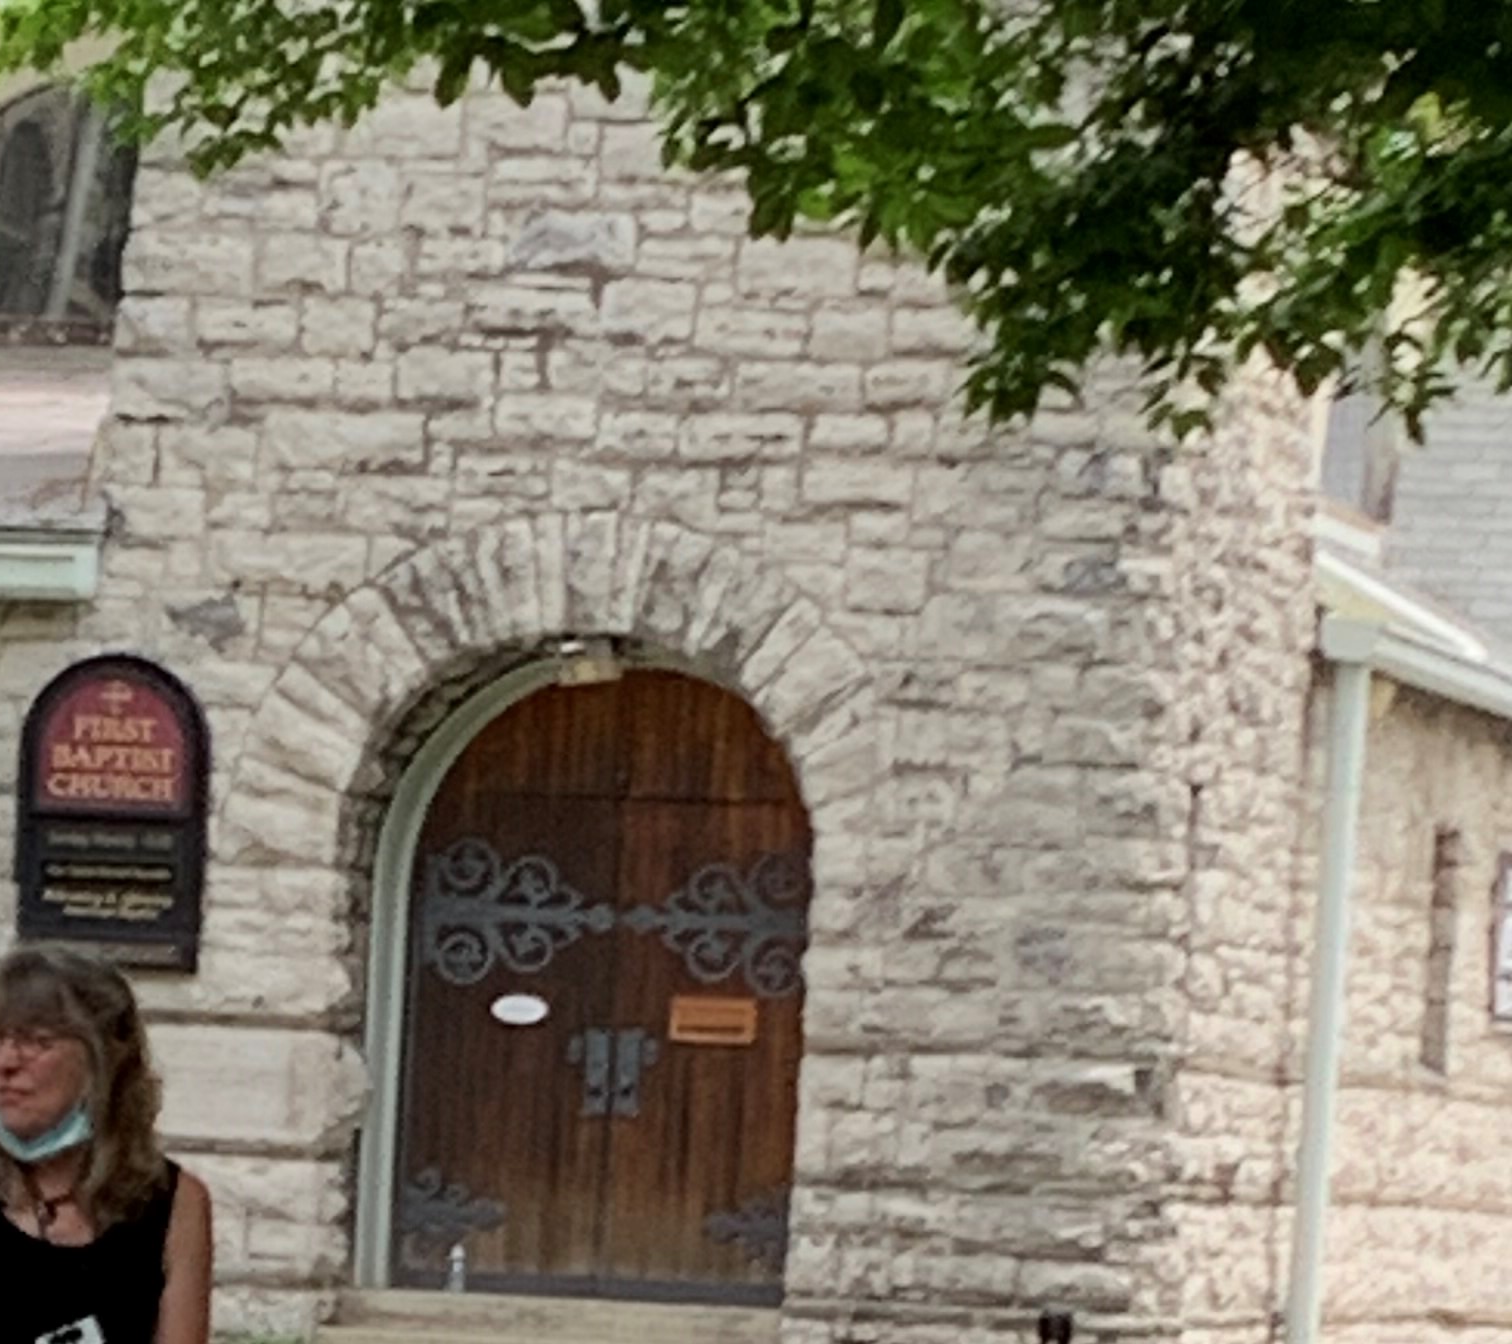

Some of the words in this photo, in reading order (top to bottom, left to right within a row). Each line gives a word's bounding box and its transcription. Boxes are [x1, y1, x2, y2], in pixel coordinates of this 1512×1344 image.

[73, 717, 157, 743] FIRST
[52, 744, 174, 772] BAPTIST
[47, 773, 174, 800] CHURCH
